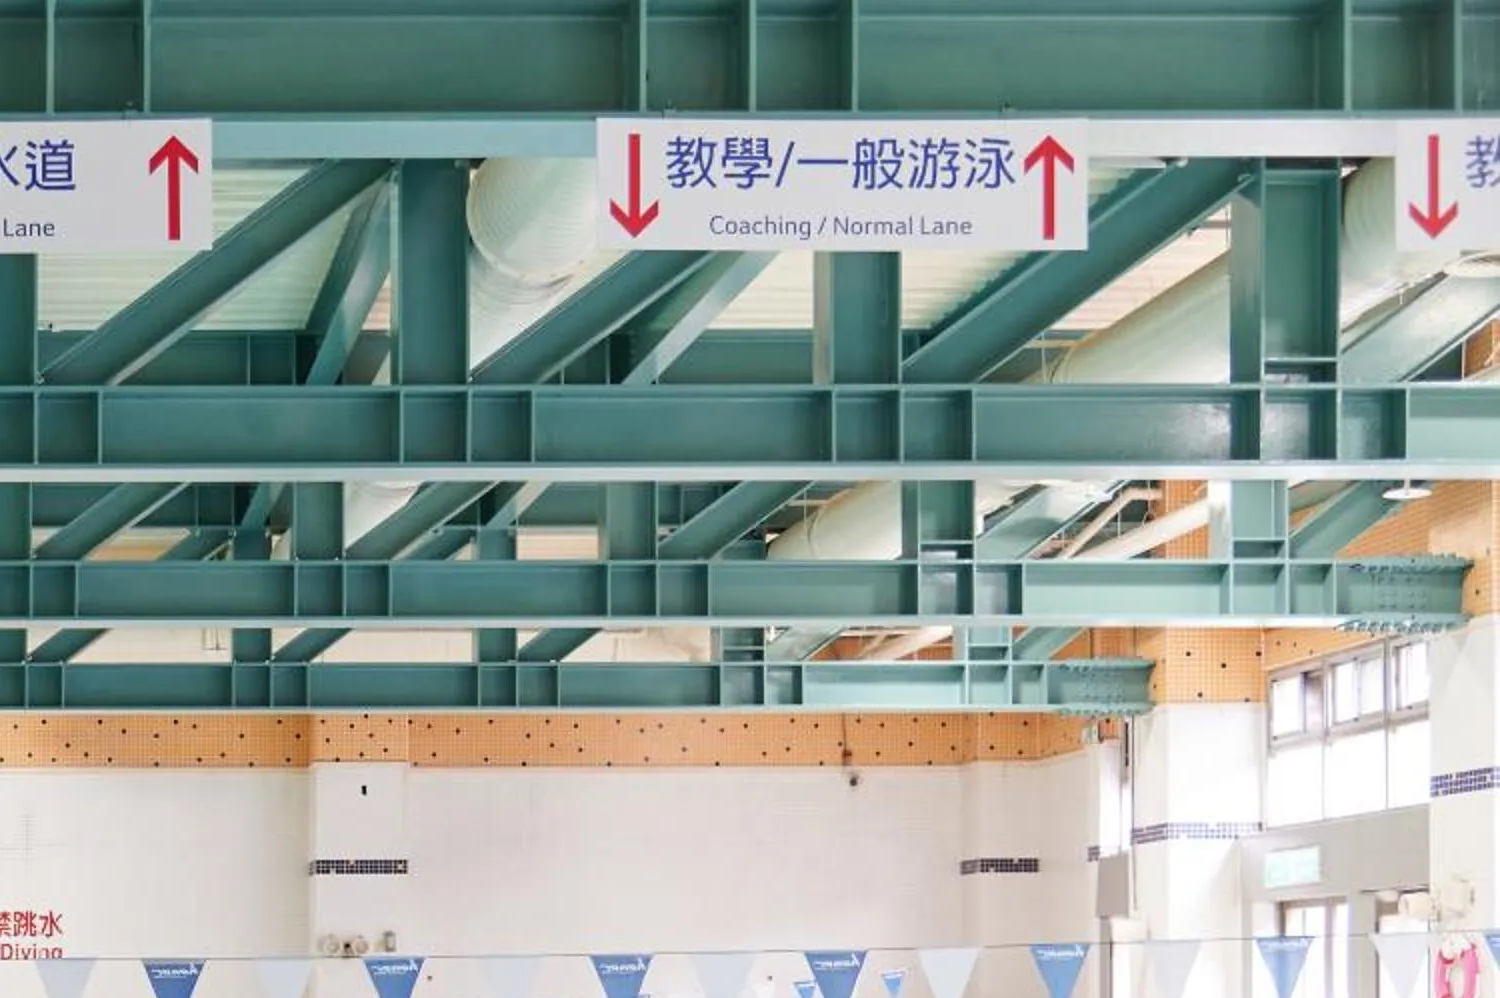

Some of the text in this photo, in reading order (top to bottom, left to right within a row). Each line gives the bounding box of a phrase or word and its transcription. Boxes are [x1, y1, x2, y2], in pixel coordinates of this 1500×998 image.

[665, 135, 1017, 191] 教學/一般游泳
[3, 217, 56, 237] Lane
[709, 214, 811, 241] Coaching
[833, 214, 913, 236] Normal
[920, 214, 972, 236] Lane
